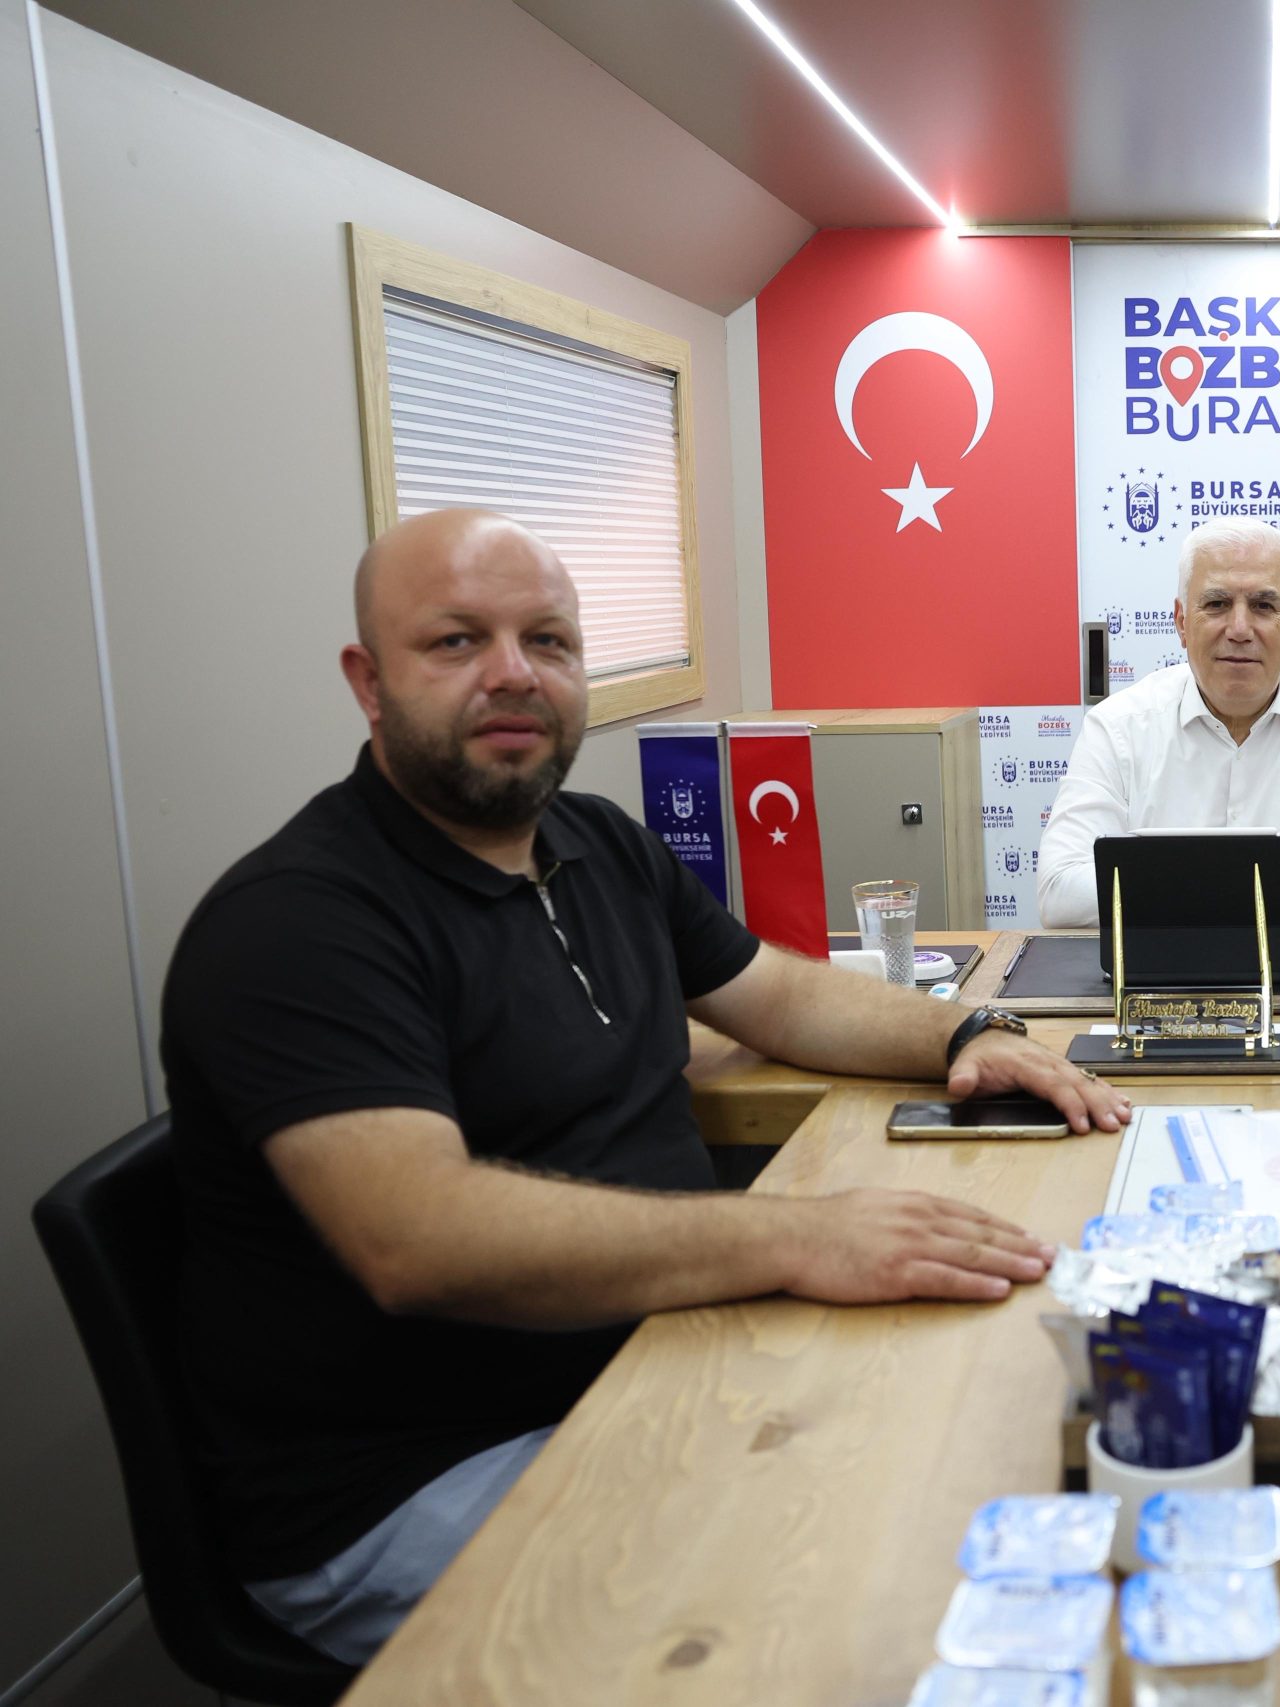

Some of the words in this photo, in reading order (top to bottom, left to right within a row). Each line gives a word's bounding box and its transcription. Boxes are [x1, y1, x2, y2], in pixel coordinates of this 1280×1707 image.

[979, 715, 1010, 724] URSA
[1029, 760, 1068, 769] BURSA
[982, 806, 1013, 814] URSA
[983, 821, 1014, 829] LEDİYESİ
[663, 832, 711, 843] BURSA
[985, 895, 1016, 903] URSA
[1130, 999, 1198, 1025] Mustafa
[1202, 999, 1259, 1024] Bozbey
[1160, 1021, 1228, 1038] Başkan
